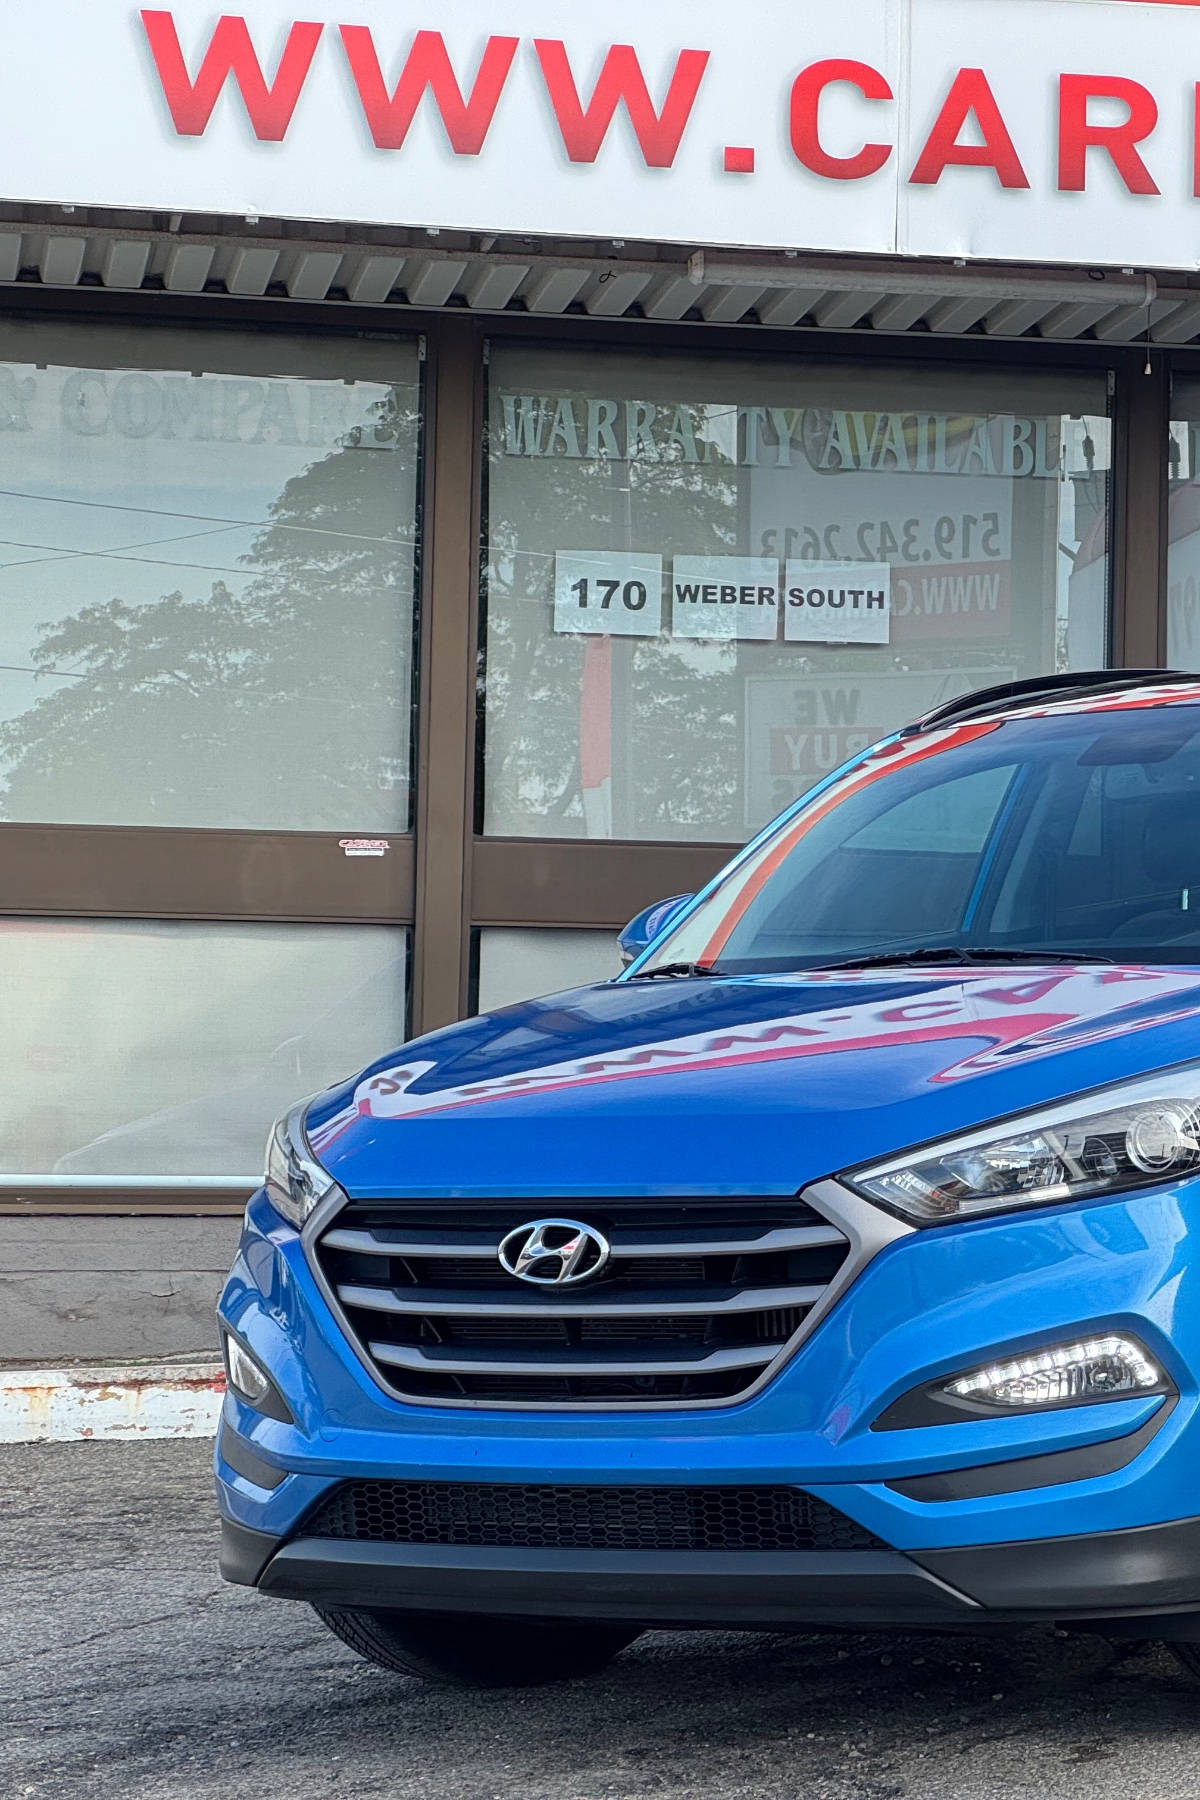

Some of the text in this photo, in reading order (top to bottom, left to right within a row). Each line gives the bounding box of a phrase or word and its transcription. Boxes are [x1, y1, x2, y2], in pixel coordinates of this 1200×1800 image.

[570, 578, 886, 611] 170 WEBER SOUTH
